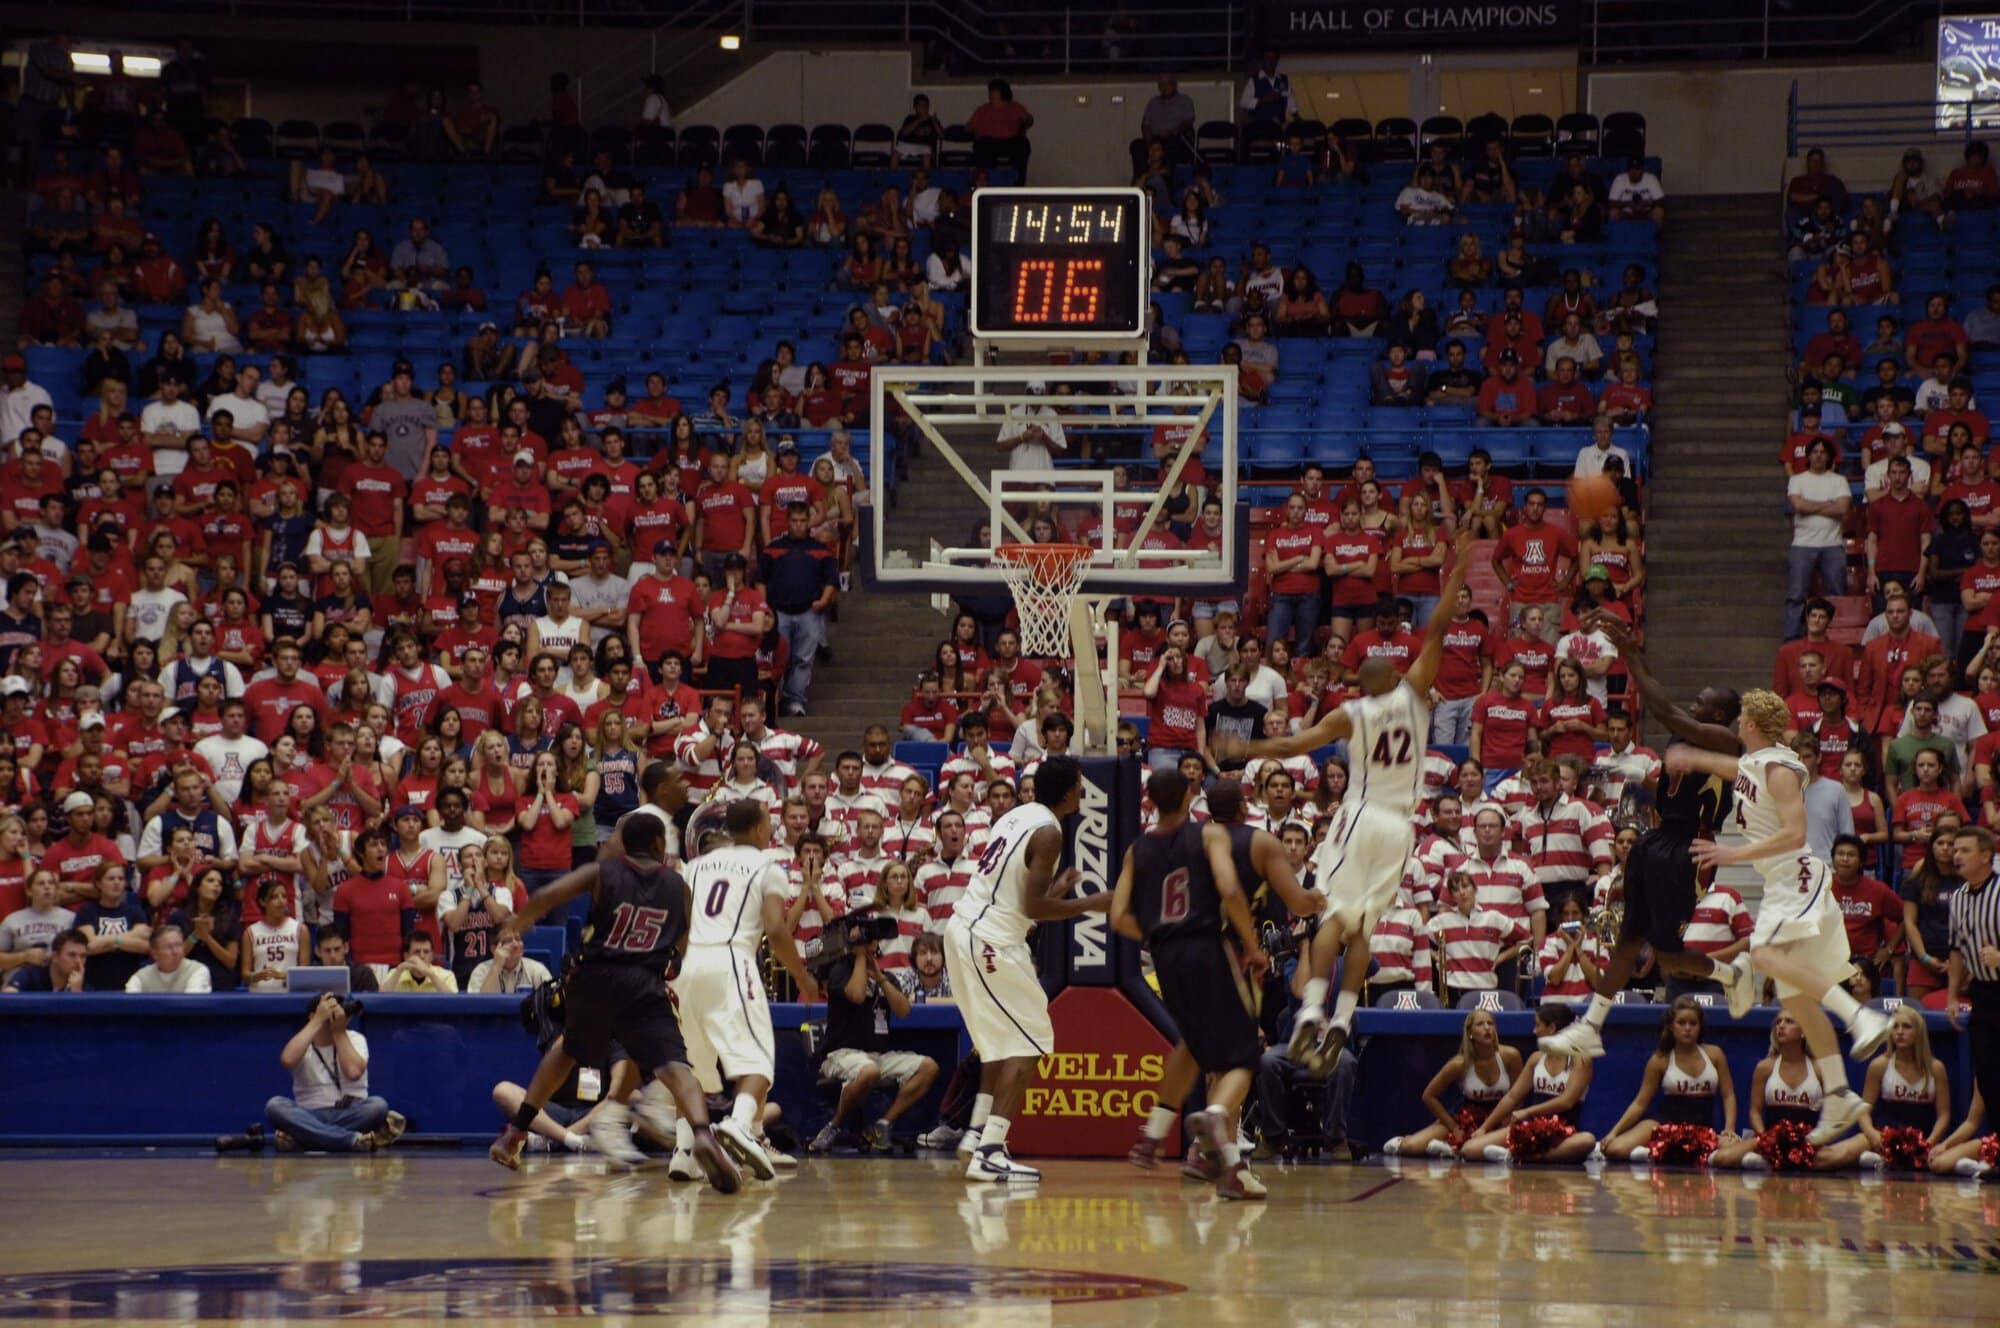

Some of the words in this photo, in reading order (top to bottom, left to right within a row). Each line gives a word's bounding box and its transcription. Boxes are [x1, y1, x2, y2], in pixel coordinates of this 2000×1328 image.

[1290, 11, 1352, 31] HALL
[1364, 9, 1393, 30] OF
[1405, 5, 1557, 29] CHAMPIONS
[1010, 204, 1123, 243] 14:54
[1014, 261, 1102, 322] 06
[1372, 727, 1412, 767] 42
[978, 836, 1007, 876] 43
[1074, 774, 1108, 966] ARIZONA
[705, 880, 730, 918] 0
[1160, 866, 1191, 925] 6
[464, 931, 487, 958] 21
[603, 902, 668, 952] 15
[267, 945, 285, 962] 55
[1021, 1088, 1162, 1118] FARGO
